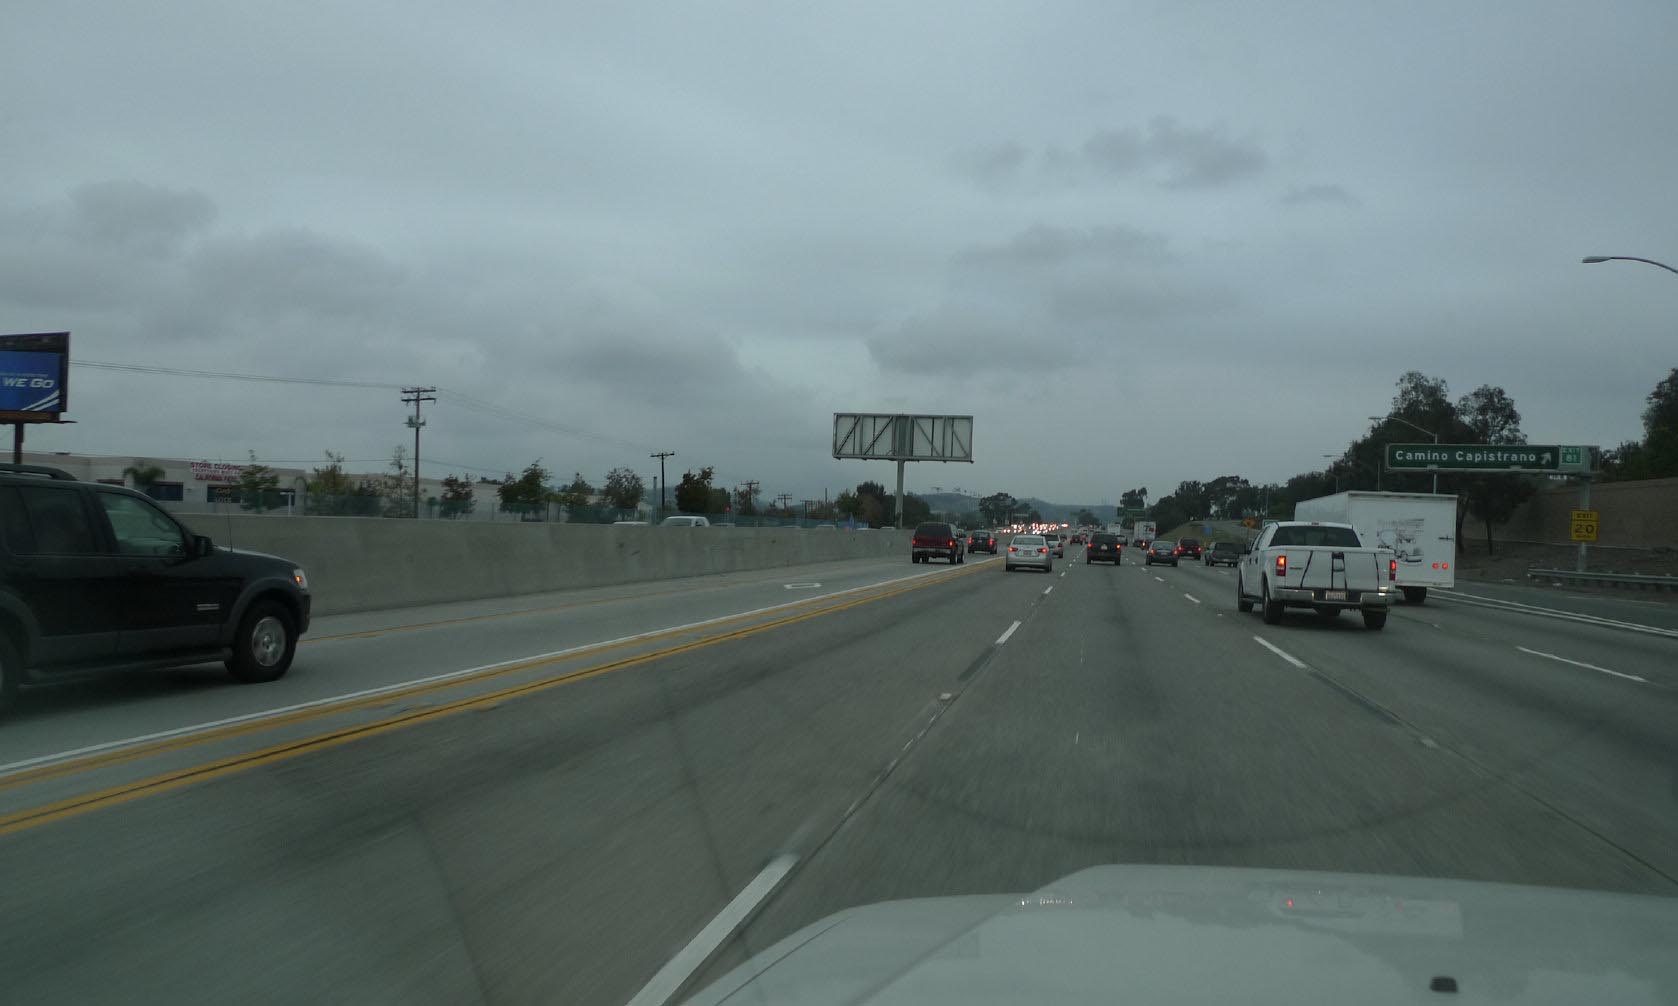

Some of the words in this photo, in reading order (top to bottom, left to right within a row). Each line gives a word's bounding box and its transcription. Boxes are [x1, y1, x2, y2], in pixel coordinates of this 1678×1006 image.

[3, 378, 28, 387] WE
[1395, 450, 1448, 461] Camino
[1455, 451, 1536, 463] Capistrano
[1576, 524, 1594, 534] 20
